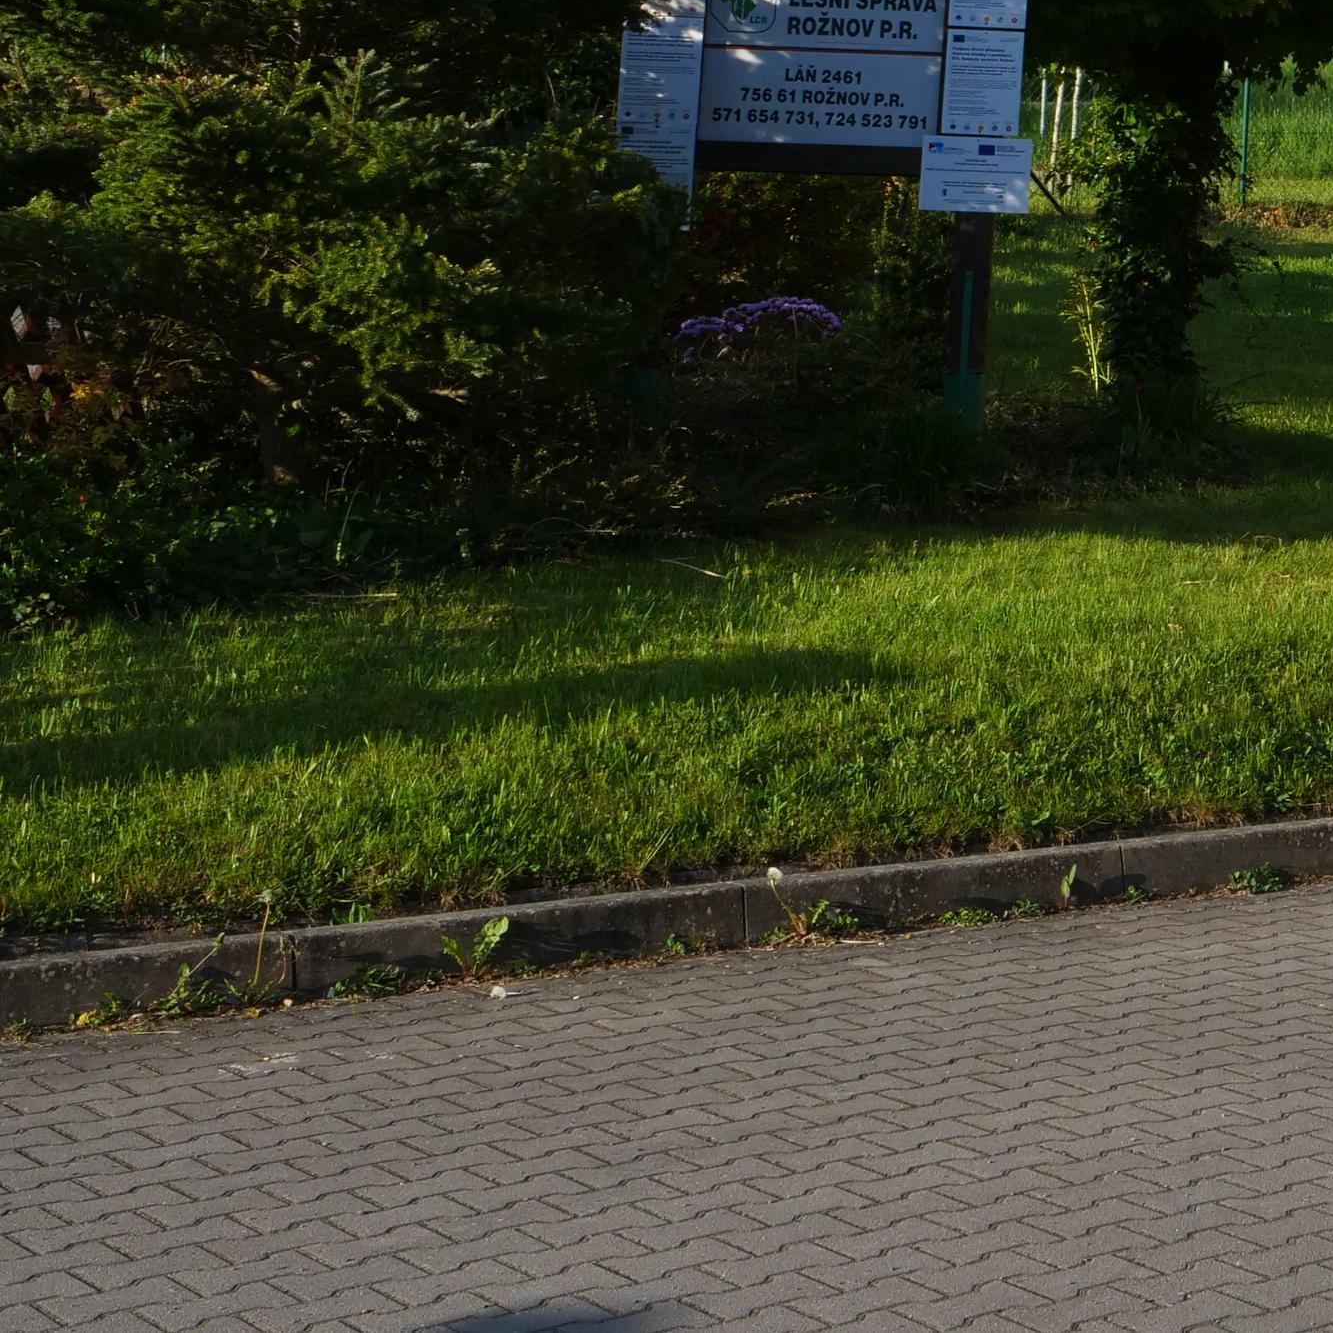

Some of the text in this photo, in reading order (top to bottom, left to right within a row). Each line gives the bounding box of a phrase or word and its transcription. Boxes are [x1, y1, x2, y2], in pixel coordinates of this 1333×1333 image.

[787, 11, 918, 40] ROŽNOV P.R.
[785, 65, 862, 85] LÁŇ 2461
[740, 87, 904, 108] 756 61 ROŽNOV P.R.
[712, 107, 927, 129] 571 654 731, 724 523 791
